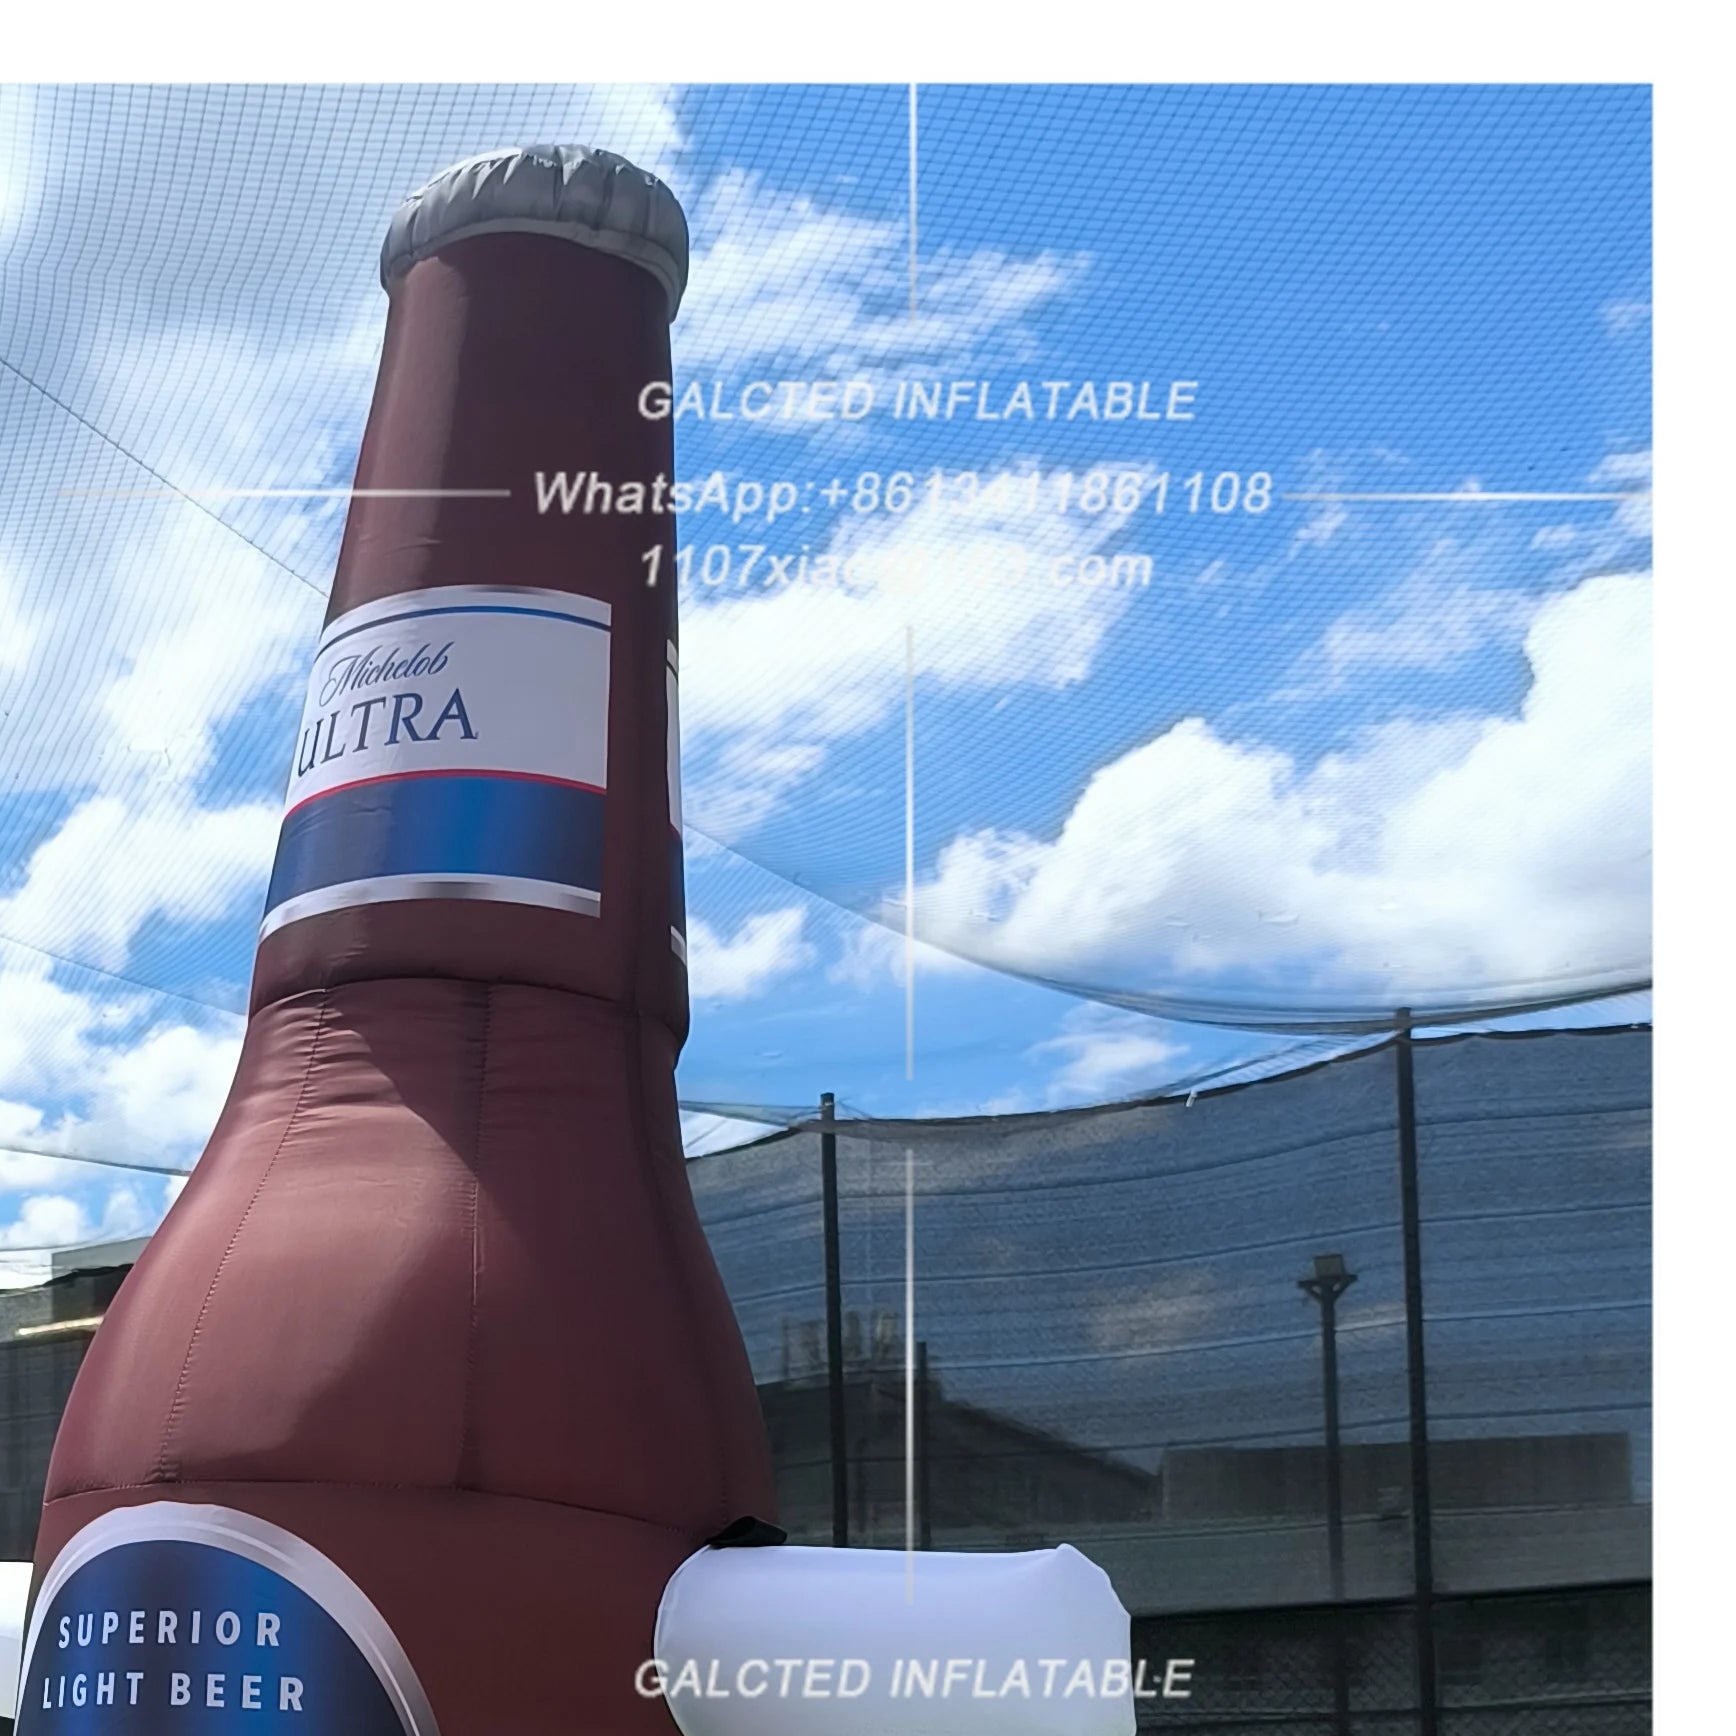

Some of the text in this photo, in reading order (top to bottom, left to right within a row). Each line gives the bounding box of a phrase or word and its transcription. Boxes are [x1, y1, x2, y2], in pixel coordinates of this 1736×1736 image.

[320, 641, 455, 707] Michelob
[59, 1611, 281, 1648] SUPERIOR
[43, 1672, 305, 1711] LIGHT BEER
